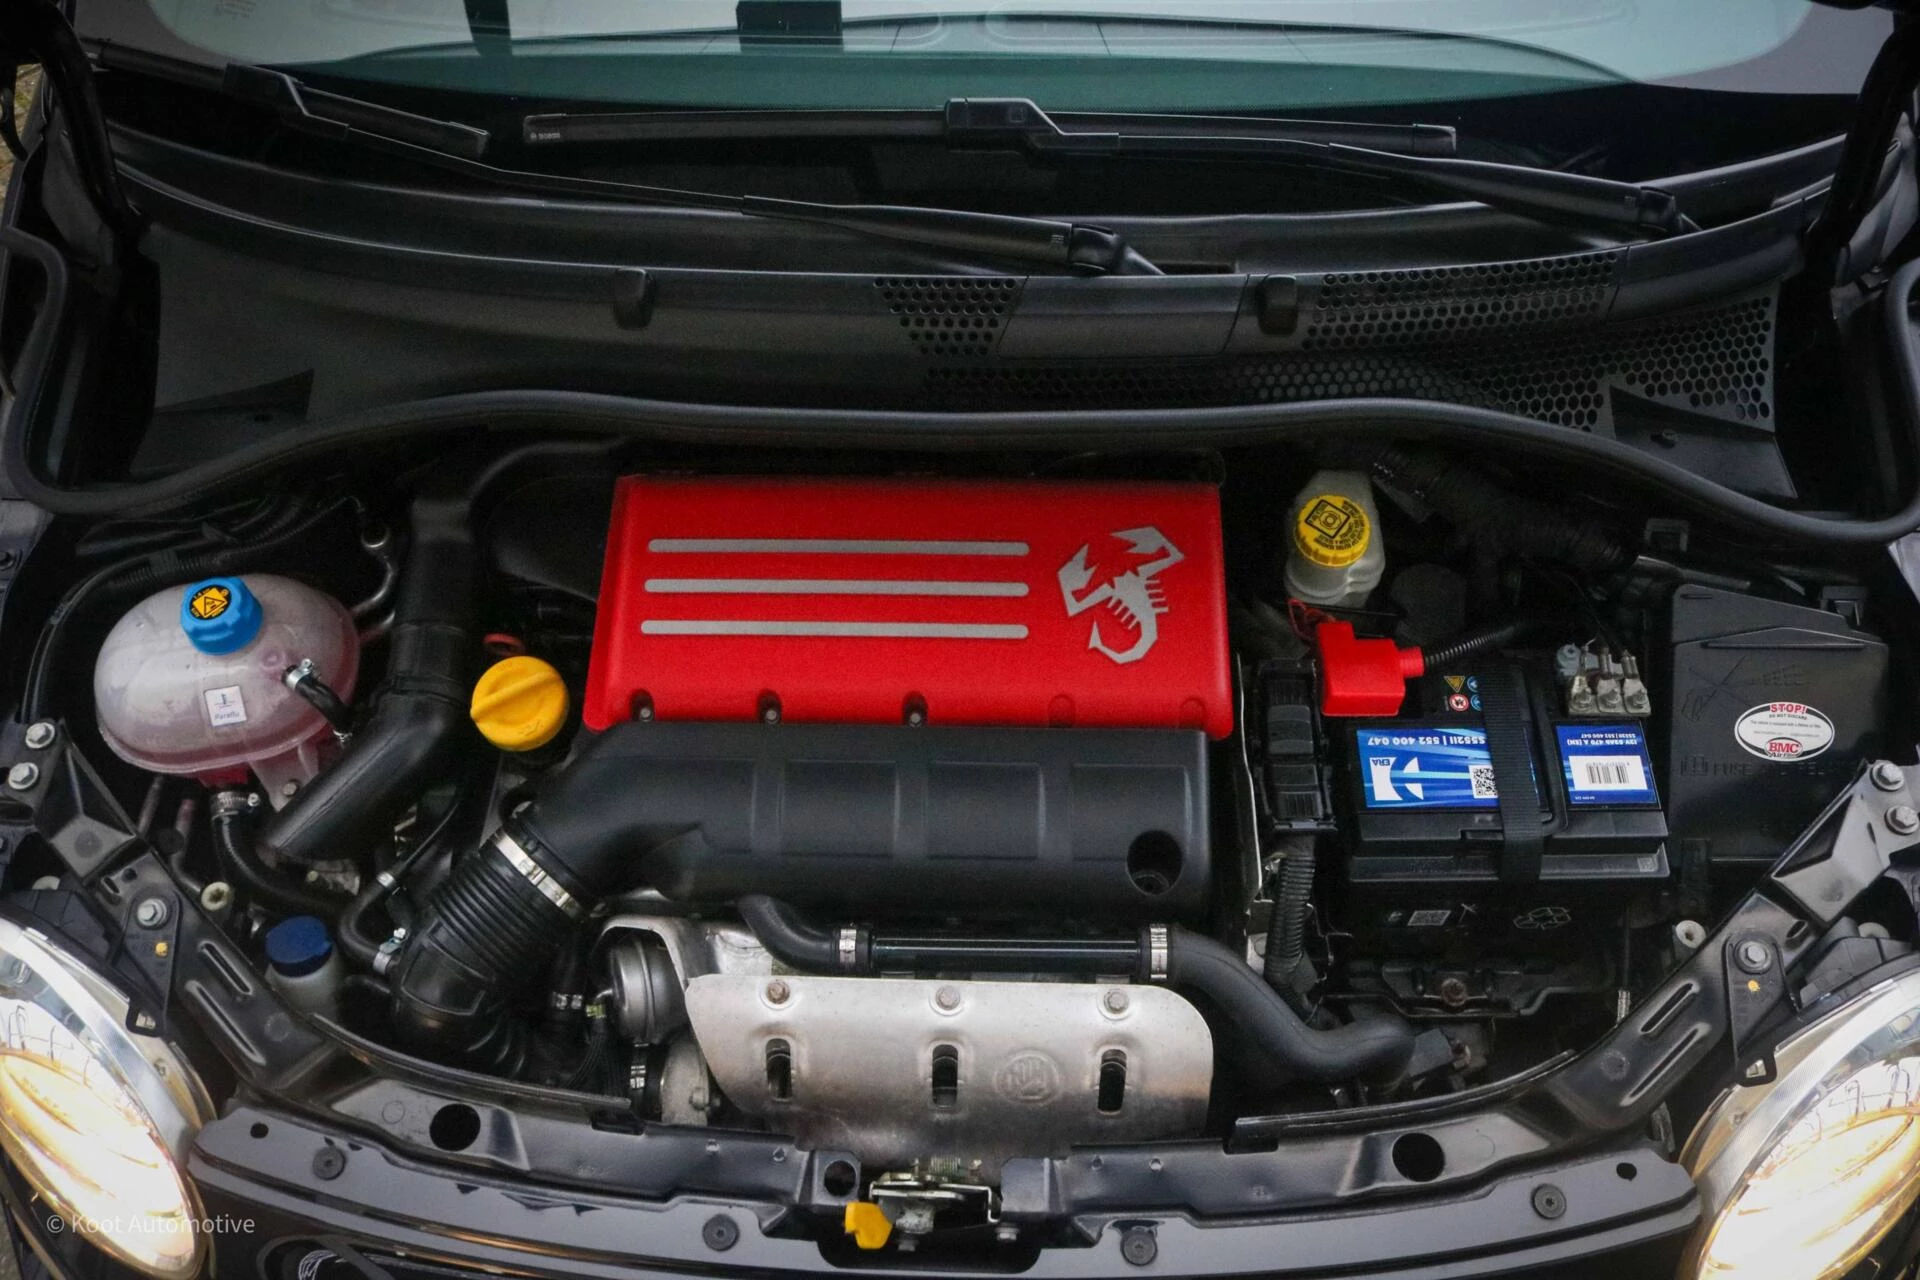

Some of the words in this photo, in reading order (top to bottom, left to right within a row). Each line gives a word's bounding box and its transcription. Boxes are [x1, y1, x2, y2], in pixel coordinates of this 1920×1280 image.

[1771, 703, 1806, 714] STOP!
[1367, 736, 1390, 746] 047
[1392, 736, 1416, 746] 400
[1418, 735, 1440, 745] 552
[1769, 742, 1799, 754] BMC
